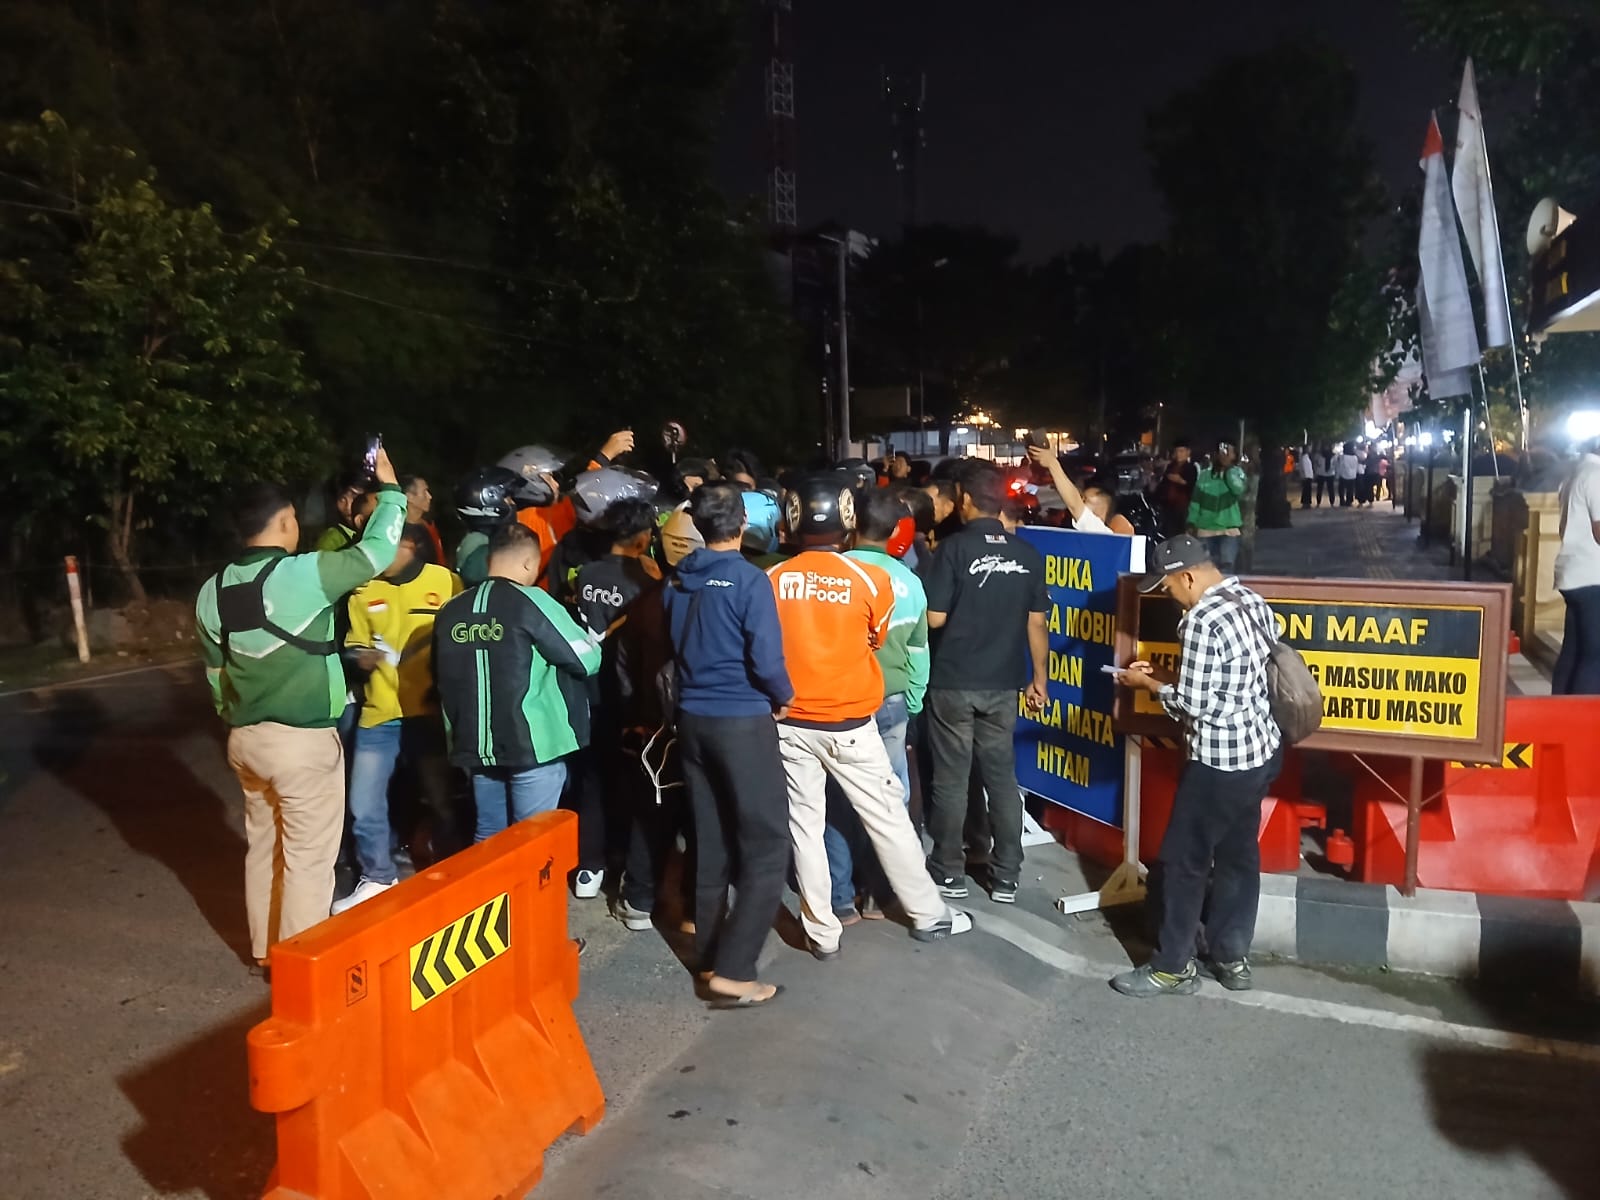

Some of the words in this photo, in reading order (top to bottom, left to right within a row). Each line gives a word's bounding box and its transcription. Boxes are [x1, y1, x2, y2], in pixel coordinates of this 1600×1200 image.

[806, 571, 852, 588] Shopee
[1045, 554, 1093, 592] BUKA
[582, 584, 624, 607] Grab
[805, 583, 851, 605] Food
[451, 616, 504, 643] Grab
[1326, 615, 1429, 646] MAAF
[1048, 650, 1083, 689] DAN
[1325, 664, 1400, 691] MASUK
[1404, 669, 1467, 695] MAKO
[1067, 703, 1115, 748] MATA
[1321, 695, 1381, 721] ARTU
[1386, 700, 1463, 726] MASUK
[1037, 741, 1090, 788] HITAM
